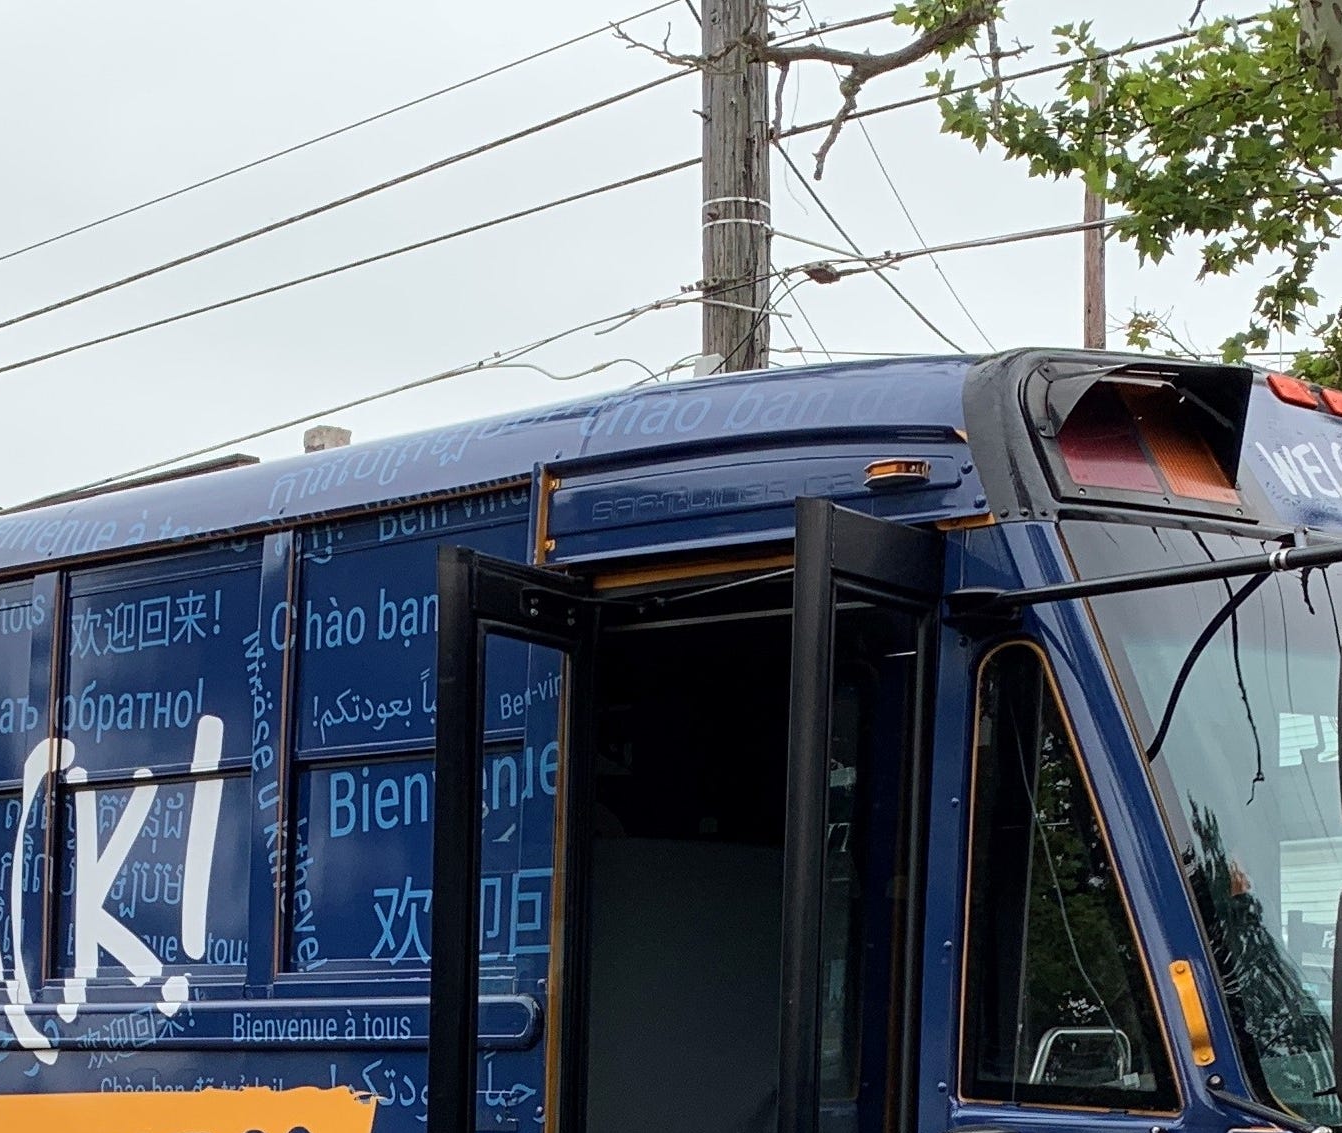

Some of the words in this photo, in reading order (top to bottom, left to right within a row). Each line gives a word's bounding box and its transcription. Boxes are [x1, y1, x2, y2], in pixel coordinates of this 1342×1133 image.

[68, 588, 223, 662] 欢迎回来!
[270, 597, 365, 652] Chào
[55, 676, 206, 744] обратно!
[232, 1012, 338, 1043] Bienvenue
[344, 1008, 357, 1039] à
[364, 1012, 411, 1041] tous
